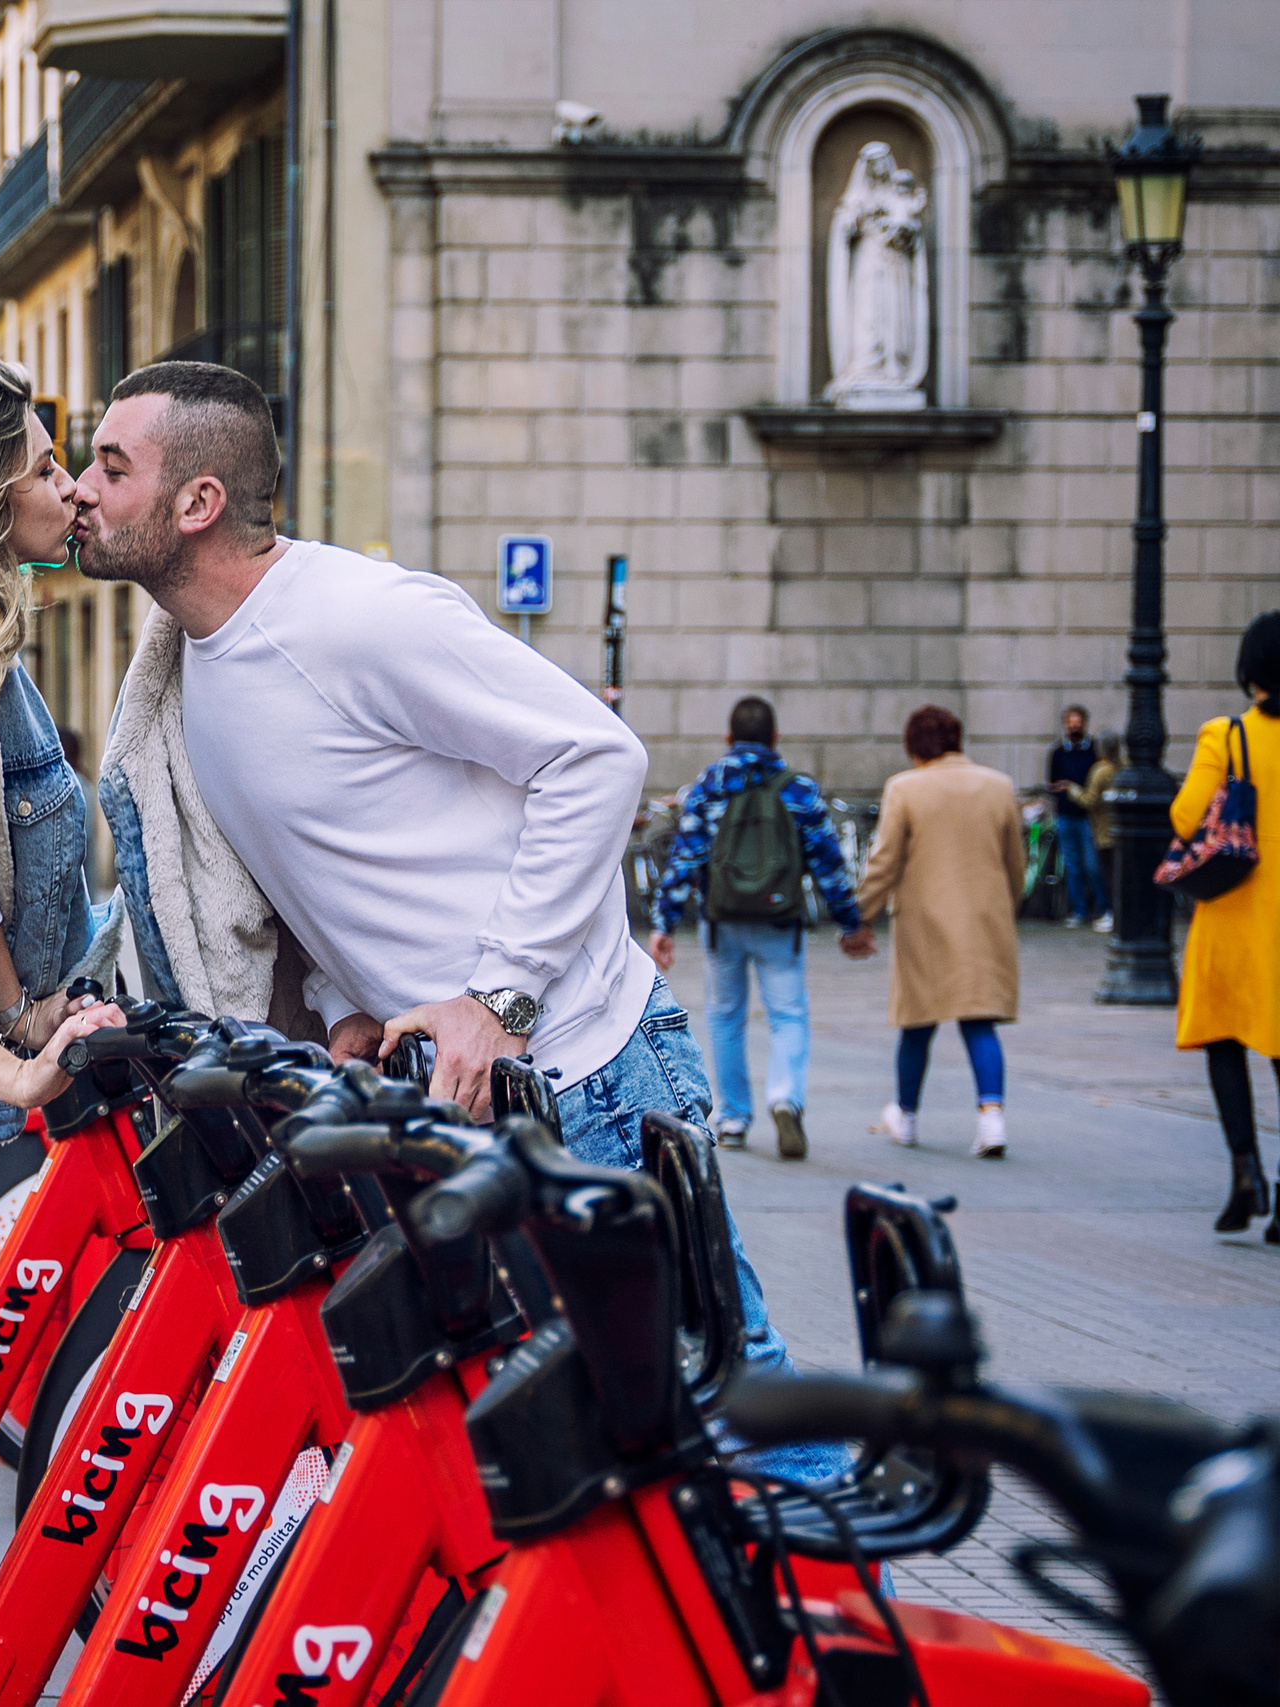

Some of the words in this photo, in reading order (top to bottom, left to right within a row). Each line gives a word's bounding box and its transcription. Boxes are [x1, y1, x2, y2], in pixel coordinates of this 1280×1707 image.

[41, 1392, 174, 1547] bicing
[115, 1483, 266, 1662] bicing
[232, 1581, 249, 1601] de
[247, 1515, 299, 1580] mobilitat
